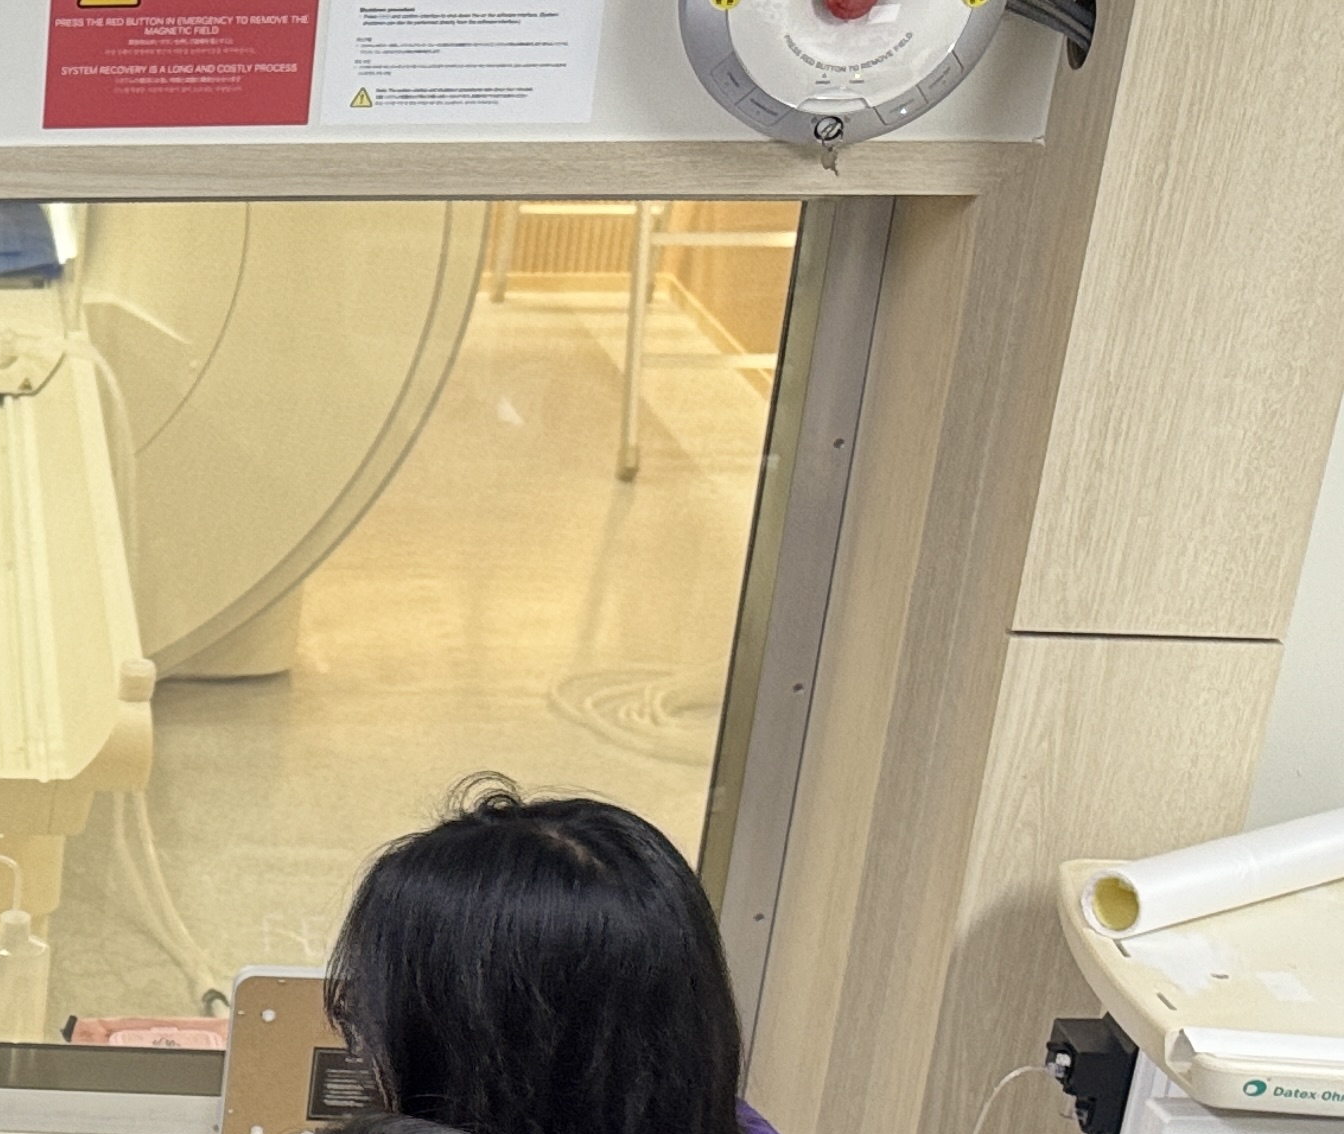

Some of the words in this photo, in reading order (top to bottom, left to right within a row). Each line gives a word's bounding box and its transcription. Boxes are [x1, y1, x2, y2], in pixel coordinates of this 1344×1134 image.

[55, 18, 84, 27] PRESS
[86, 18, 104, 27] THE
[105, 18, 124, 27] RED
[126, 17, 164, 26] BUTTON
[165, 16, 175, 26] IN
[177, 16, 234, 25] EMERGENCY
[236, 16, 248, 25] TO
[250, 15, 289, 24] REMOVE
[291, 14, 309, 24] THE
[144, 26, 192, 36] MAGNETIC
[194, 26, 219, 35] FIELD
[816, 61, 847, 73] BUTTON
[848, 64, 860, 73] TO
[860, 50, 894, 71] REMOVE
[61, 66, 98, 76] SYSTEM
[99, 65, 147, 74] RECOVERY
[148, 65, 158, 74] IS
[159, 65, 166, 74] A
[167, 64, 194, 74] LONG
[194, 64, 216, 73] AND
[217, 64, 252, 73] COSTLY
[254, 63, 297, 73] PROCESS
[1273, 1086, 1317, 1100] Datex
[1321, 1091, 1344, 1102] Oh
